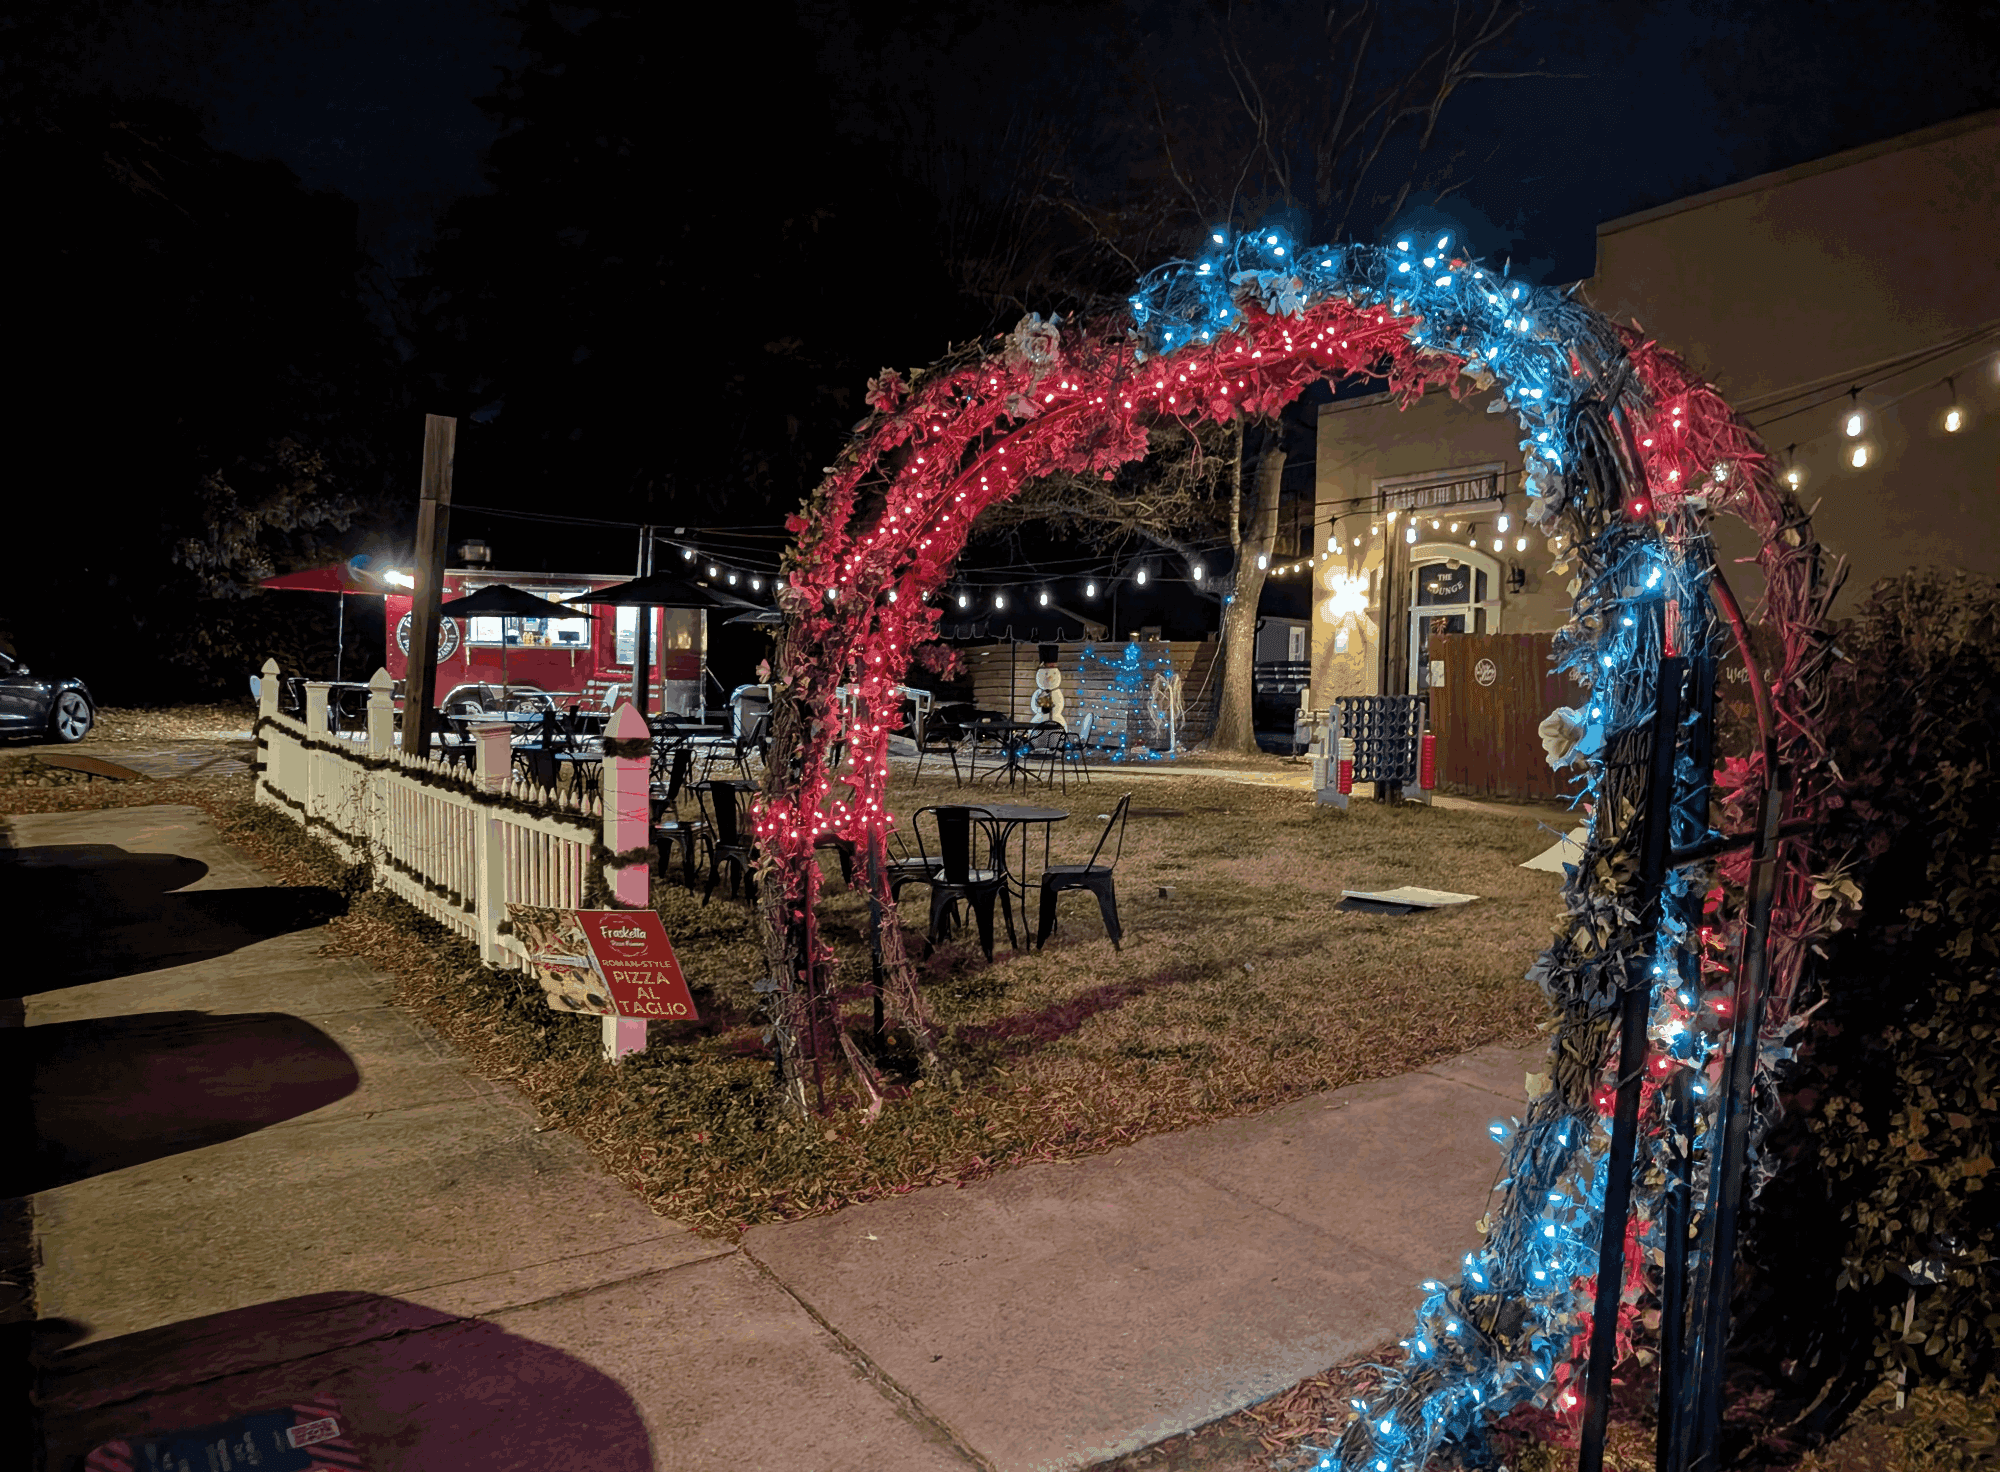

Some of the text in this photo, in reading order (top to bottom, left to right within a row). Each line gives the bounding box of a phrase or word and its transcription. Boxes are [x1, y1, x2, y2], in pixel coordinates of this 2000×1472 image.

[1416, 489, 1430, 506] OF
[1432, 486, 1452, 504] THE
[1437, 573, 1453, 581] THE
[1427, 580, 1464, 596] OUNGE
[602, 959, 671, 968] ROMAN-STYLE
[612, 971, 671, 985] PIZZA
[637, 987, 660, 999] AL
[619, 1000, 688, 1016] TAGLIO
